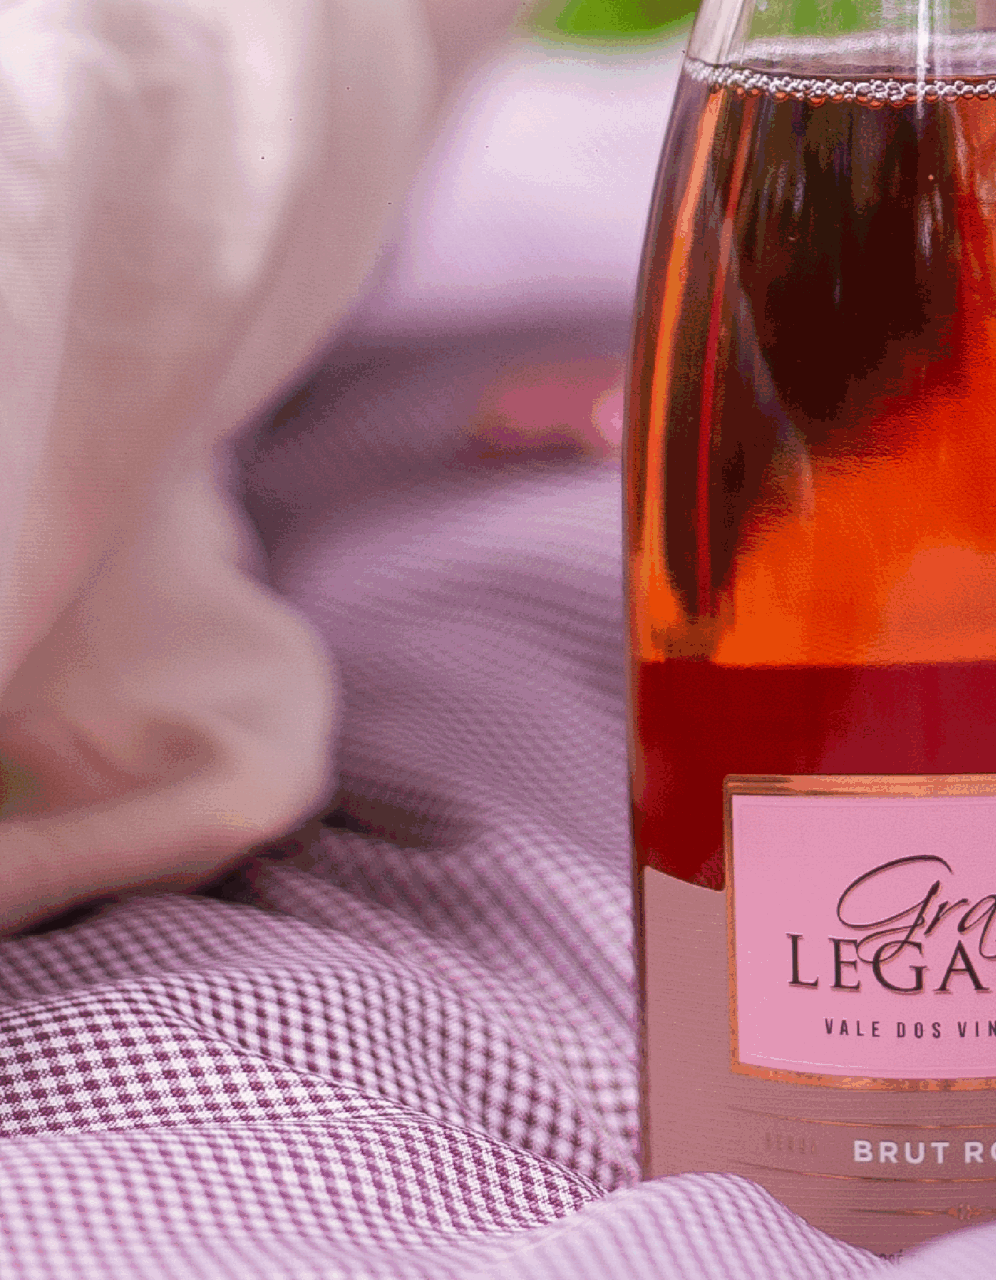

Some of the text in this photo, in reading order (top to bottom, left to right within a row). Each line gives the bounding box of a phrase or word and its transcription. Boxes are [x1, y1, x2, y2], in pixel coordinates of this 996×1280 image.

[824, 1018, 882, 1038] VALE
[896, 1020, 942, 1038] DOS
[853, 1140, 950, 1164] BRUT
